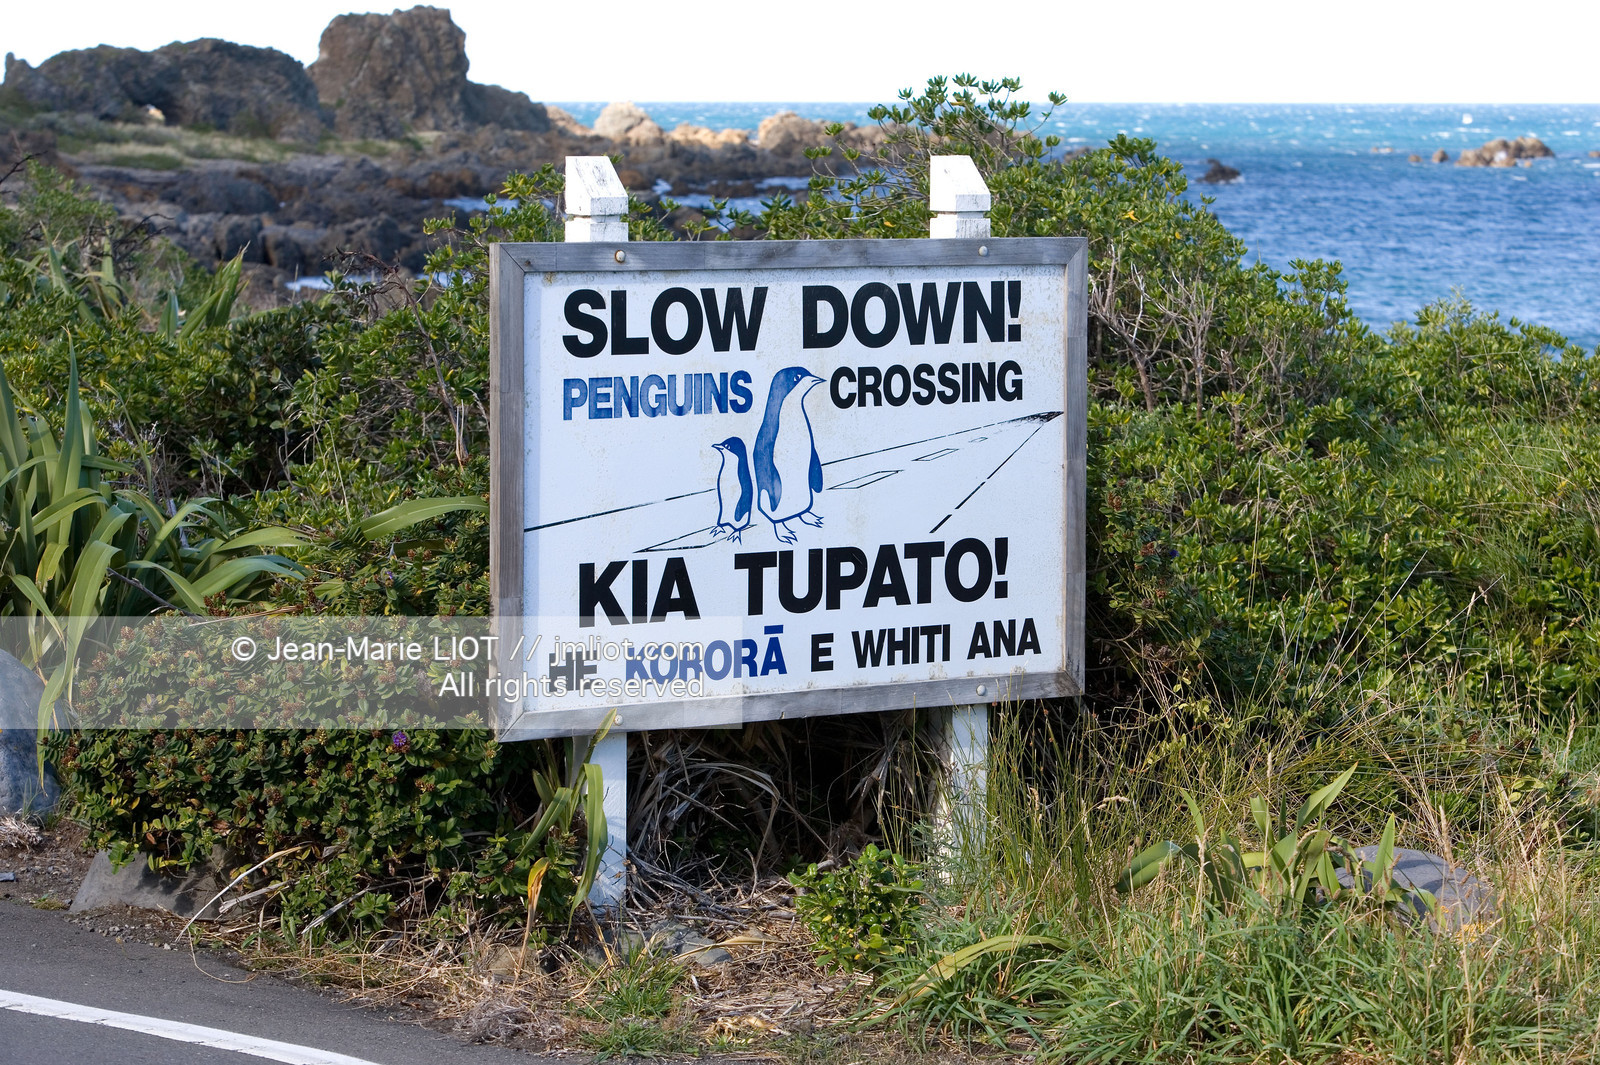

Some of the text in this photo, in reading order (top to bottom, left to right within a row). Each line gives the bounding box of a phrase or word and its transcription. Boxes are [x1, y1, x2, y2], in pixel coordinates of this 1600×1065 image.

[562, 280, 1022, 358] SLOW DOWN!
[562, 360, 1023, 420] PENGUINS CROSSING
[578, 537, 1009, 628] KIA TUPATO!
[549, 617, 1042, 693] HE KORORĀ E WHITI ANA
